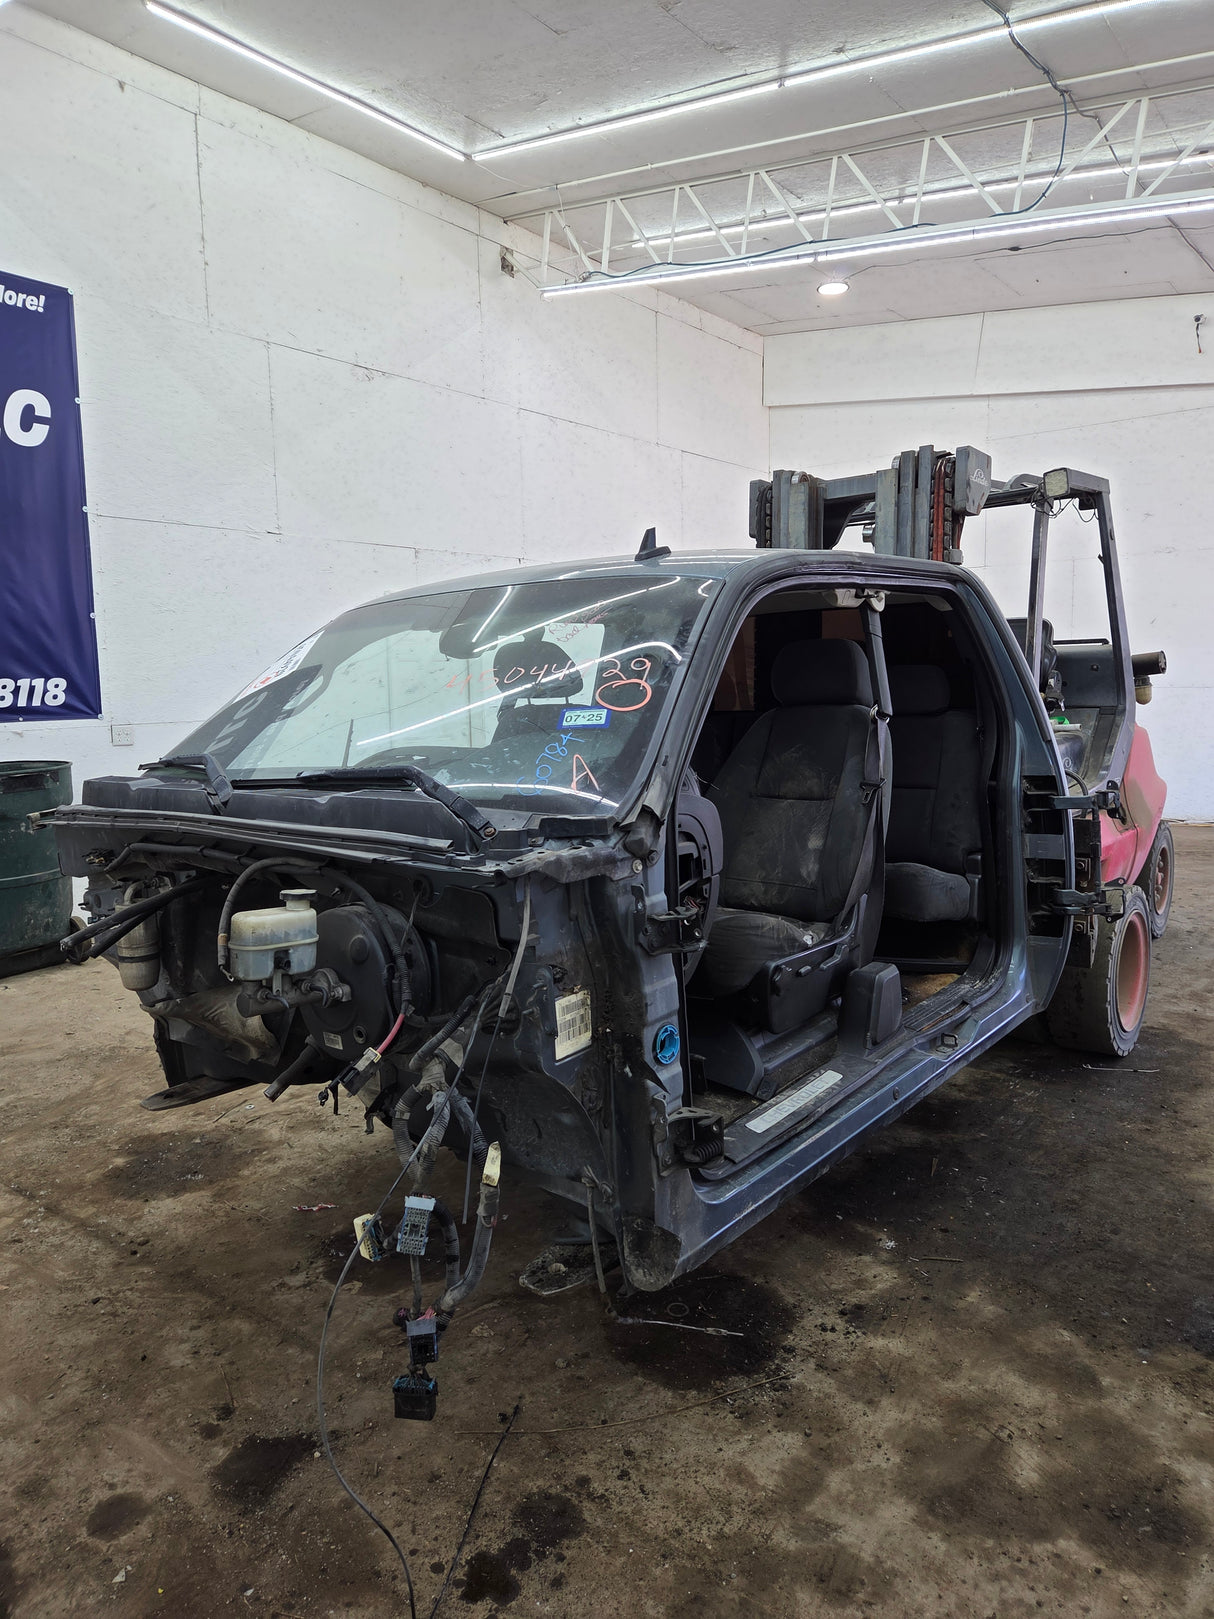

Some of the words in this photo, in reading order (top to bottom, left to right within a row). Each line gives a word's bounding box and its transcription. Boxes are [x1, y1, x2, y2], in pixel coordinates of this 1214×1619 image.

[0, 389, 51, 447] C
[0, 678, 67, 708] 8118
[571, 754, 602, 794] A
[760, 1077, 830, 1124] CHEVROLET
